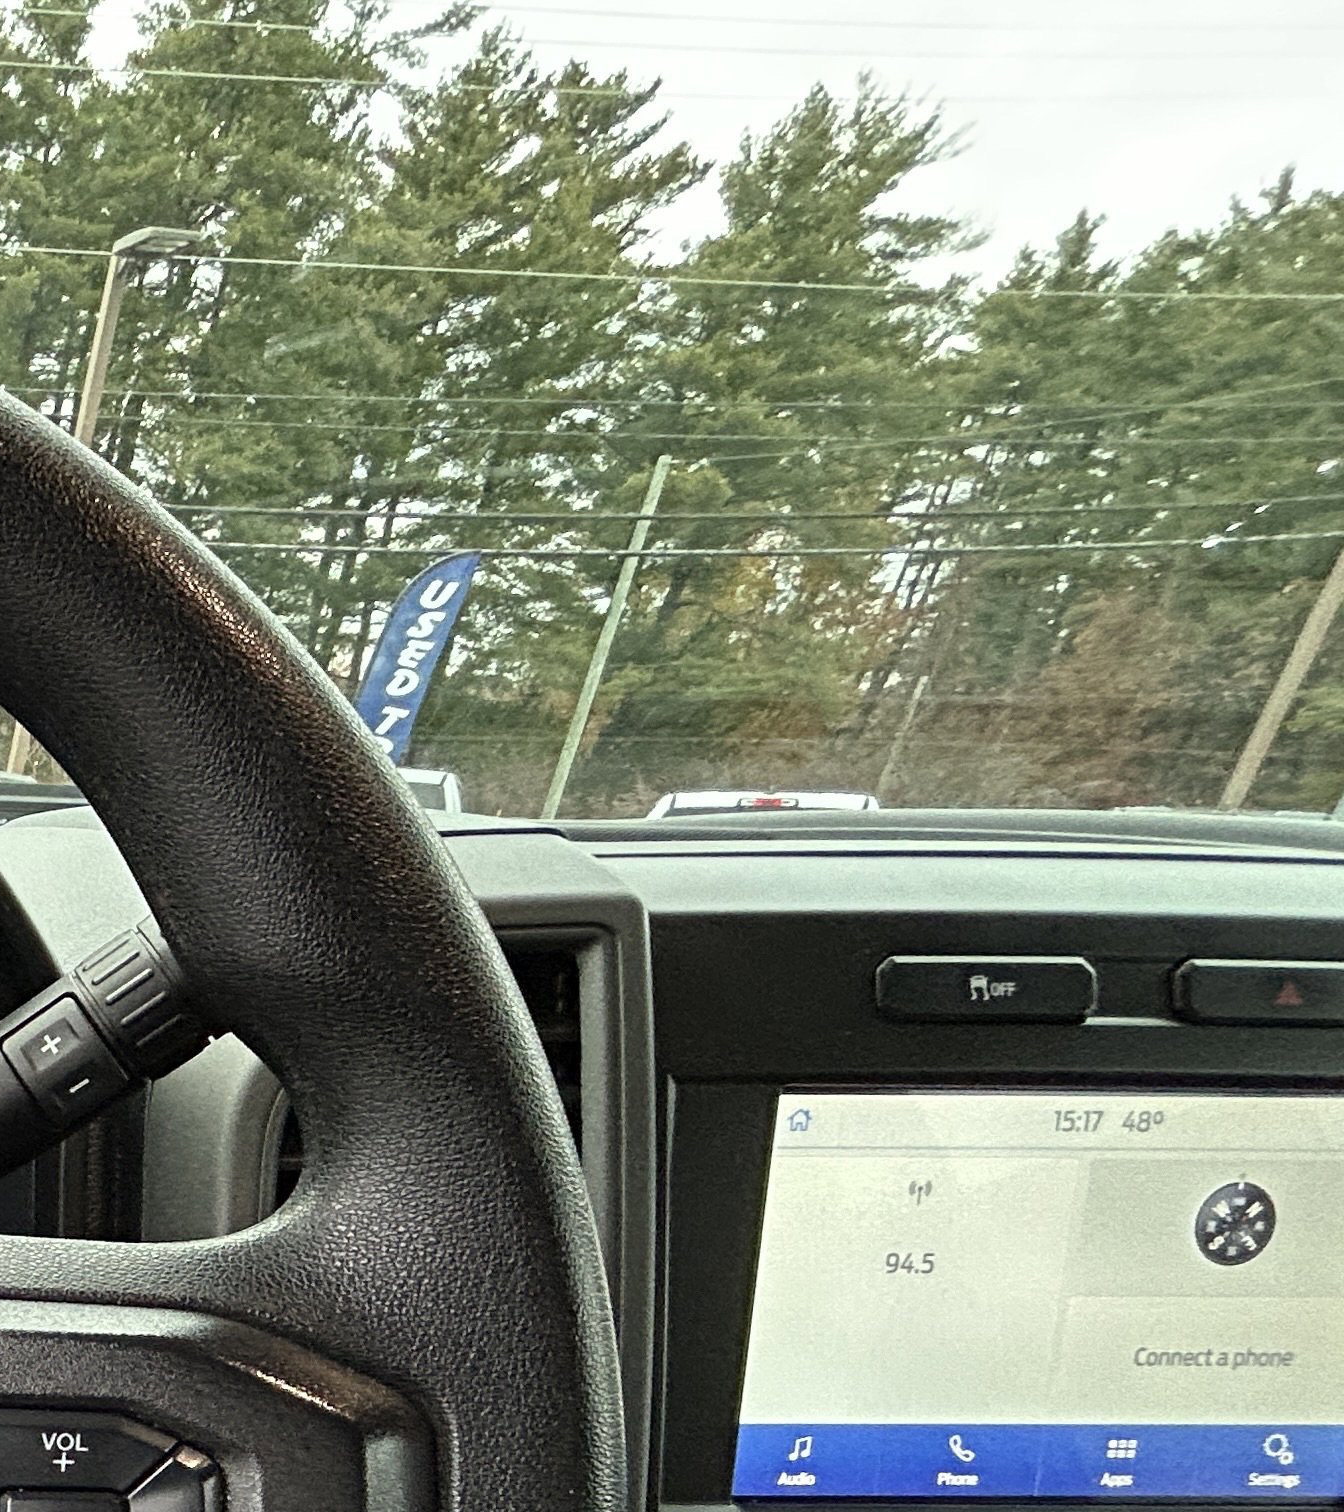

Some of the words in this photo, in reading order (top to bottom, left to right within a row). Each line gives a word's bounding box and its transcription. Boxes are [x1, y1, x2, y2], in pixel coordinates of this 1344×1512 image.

[386, 579, 459, 697] USED
[990, 982, 1016, 997] OFF
[1054, 1110, 1104, 1132] 15:17
[884, 1251, 936, 1276] 94.5
[1134, 1347, 1212, 1367] Connect
[1215, 1352, 1229, 1366] a
[1232, 1347, 1294, 1370] phone
[41, 1432, 89, 1452] VOL
[777, 1472, 816, 1486] Audio
[937, 1472, 979, 1486] Phone
